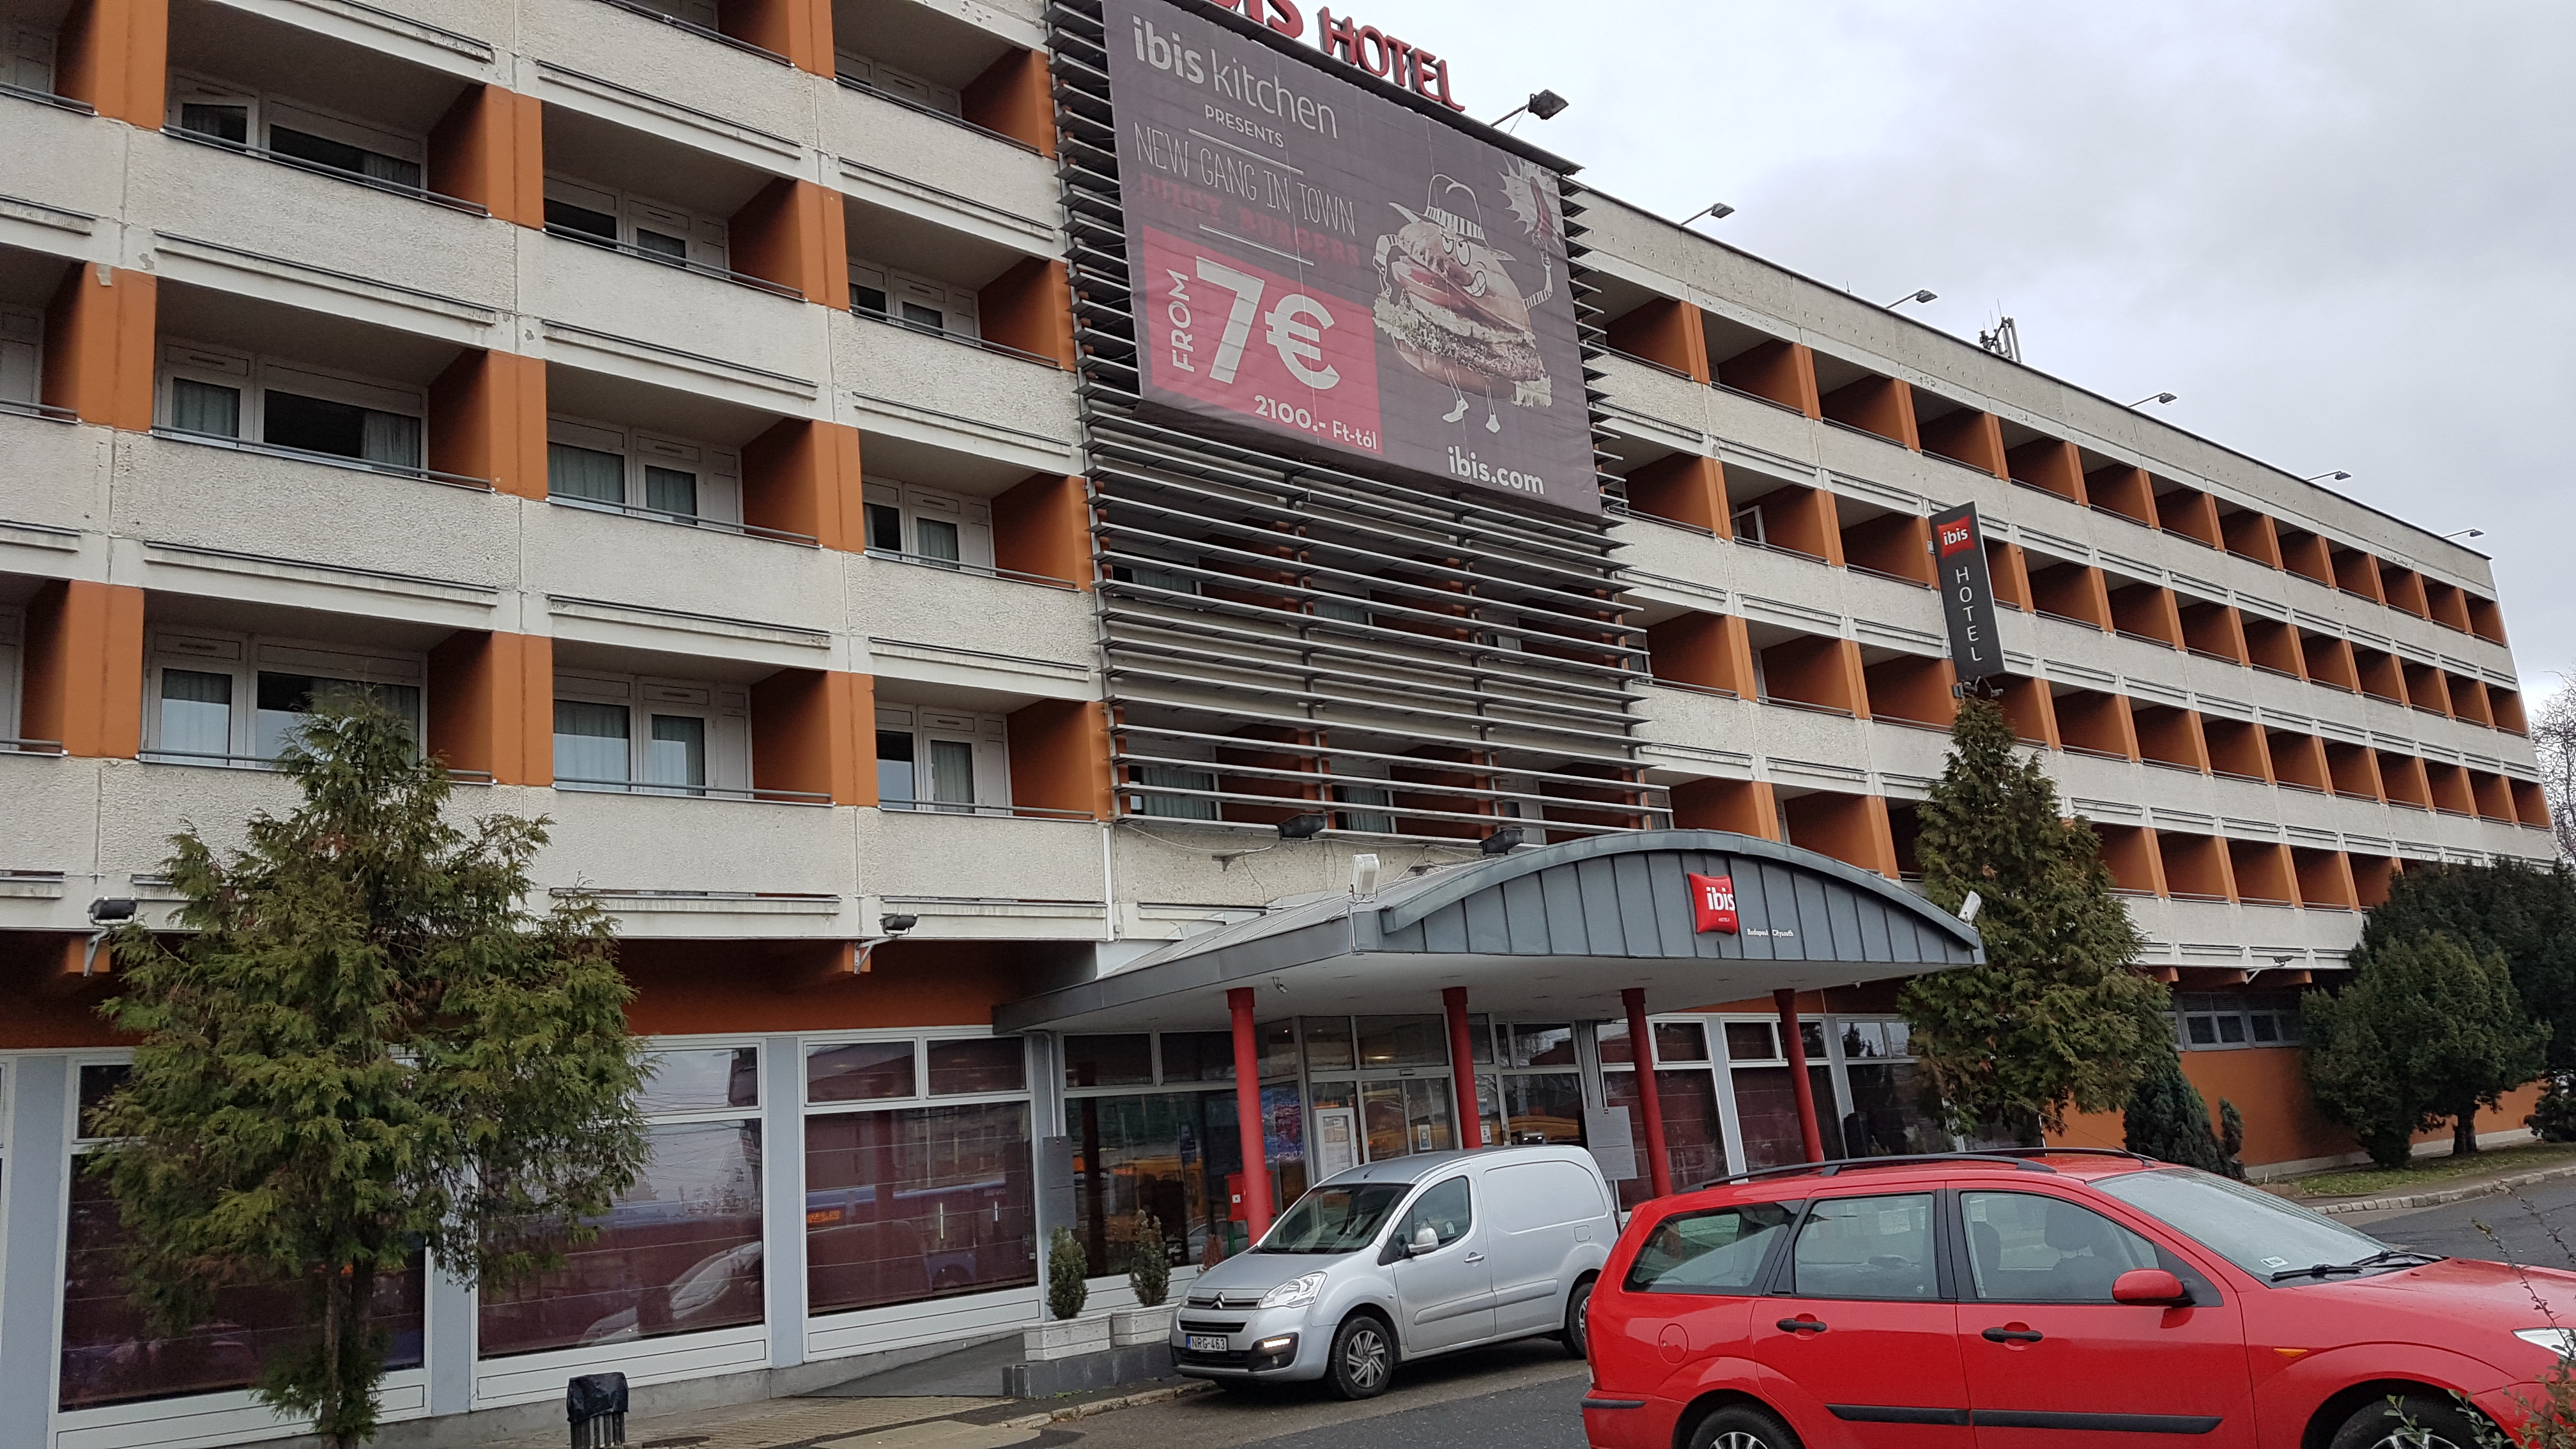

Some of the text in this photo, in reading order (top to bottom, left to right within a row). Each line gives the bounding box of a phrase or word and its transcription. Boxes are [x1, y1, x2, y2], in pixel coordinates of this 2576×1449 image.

[1133, 16, 1205, 85] ibis
[1212, 48, 1338, 139] kitchen
[1317, 6, 1465, 112] HOTEL
[1206, 105, 1284, 148] PRESENTS
[1134, 123, 1356, 236] NEW GANG IN TOWN
[1166, 268, 1195, 373] FROM
[1195, 256, 1340, 390] 7€
[1333, 419, 1378, 450] Ft-tól
[1448, 446, 1545, 496] ibis.com
[1943, 528, 1968, 546] ibis
[1955, 566, 1982, 662] HOTEL
[1706, 886, 1735, 911] ibis
[1192, 1337, 1225, 1350] NRG-463
